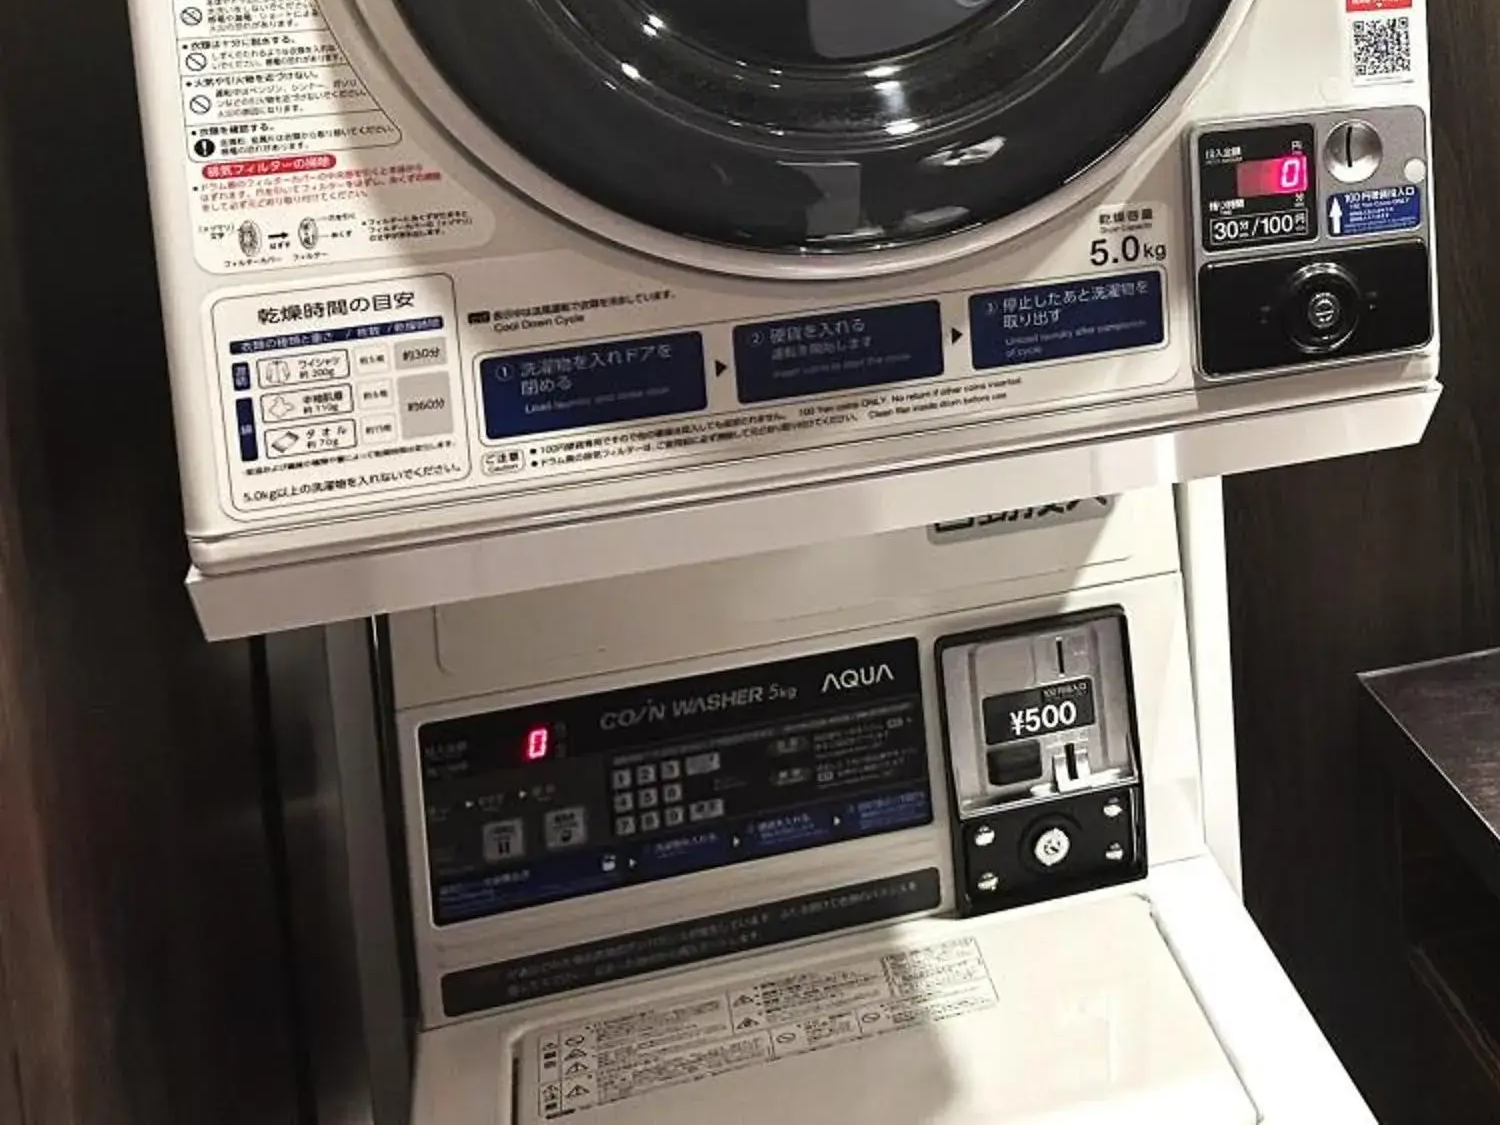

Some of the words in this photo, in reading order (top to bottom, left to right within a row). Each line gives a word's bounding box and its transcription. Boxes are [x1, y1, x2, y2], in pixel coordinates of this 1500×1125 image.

[1280, 158, 1301, 189] 0
[1090, 235, 1167, 267] 5.0kg
[257, 290, 415, 325] 乾燥時間の目安
[556, 312, 585, 328] Cycle
[1002, 308, 1063, 331] 取り出す
[520, 376, 574, 397] 閉める
[820, 663, 895, 695] AQUA
[599, 698, 665, 731] COIN
[671, 687, 764, 720] WASHER
[767, 682, 798, 702] 5kg
[1009, 700, 1077, 736] ¥500
[527, 728, 548, 761] 0
